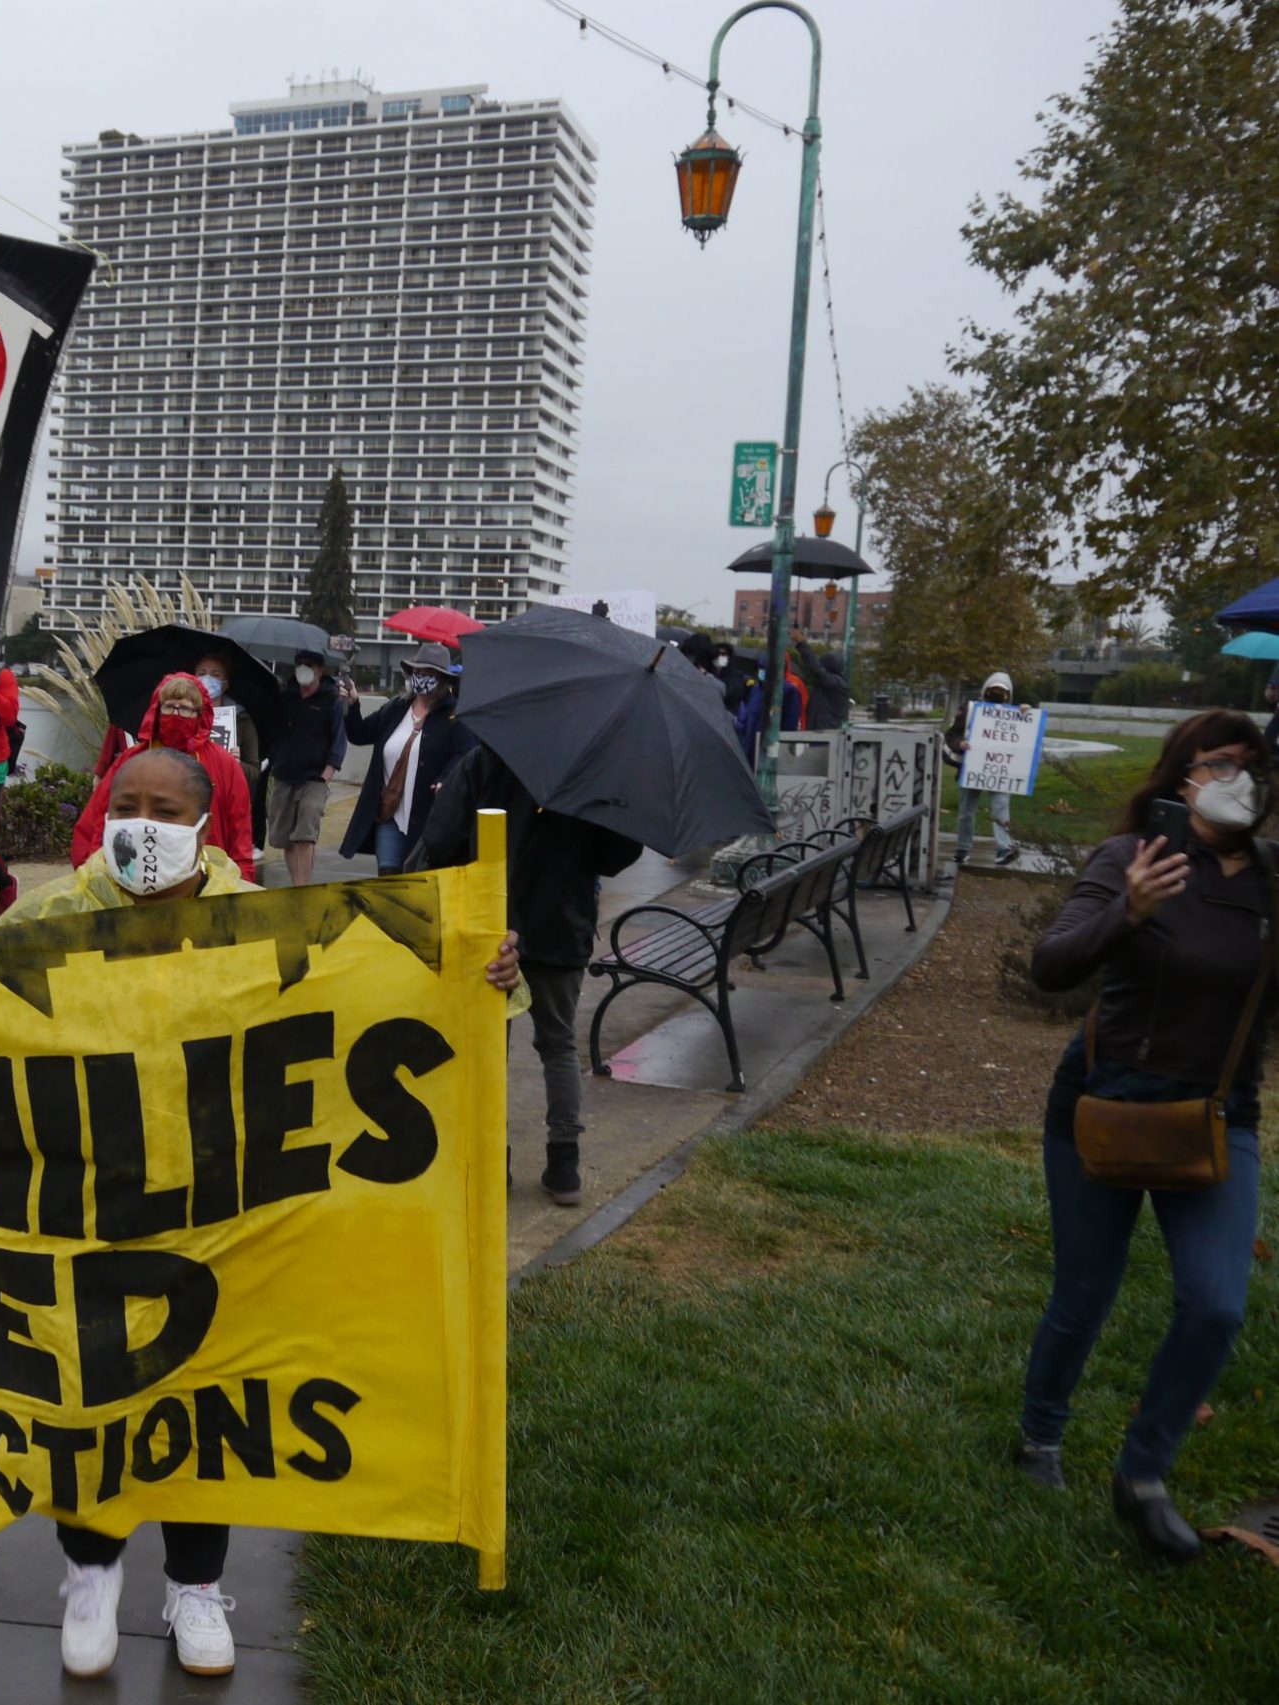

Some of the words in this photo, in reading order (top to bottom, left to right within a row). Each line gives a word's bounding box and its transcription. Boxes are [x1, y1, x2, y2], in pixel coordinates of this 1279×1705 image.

[982, 706, 1033, 723] HOUSING
[994, 720, 1017, 732] FOR
[982, 729, 1020, 743] NEED
[985, 752, 1015, 764] NOT
[983, 763, 1008, 776] FOR
[966, 772, 1024, 792] PROFIT
[143, 826, 157, 893] DAYONNA
